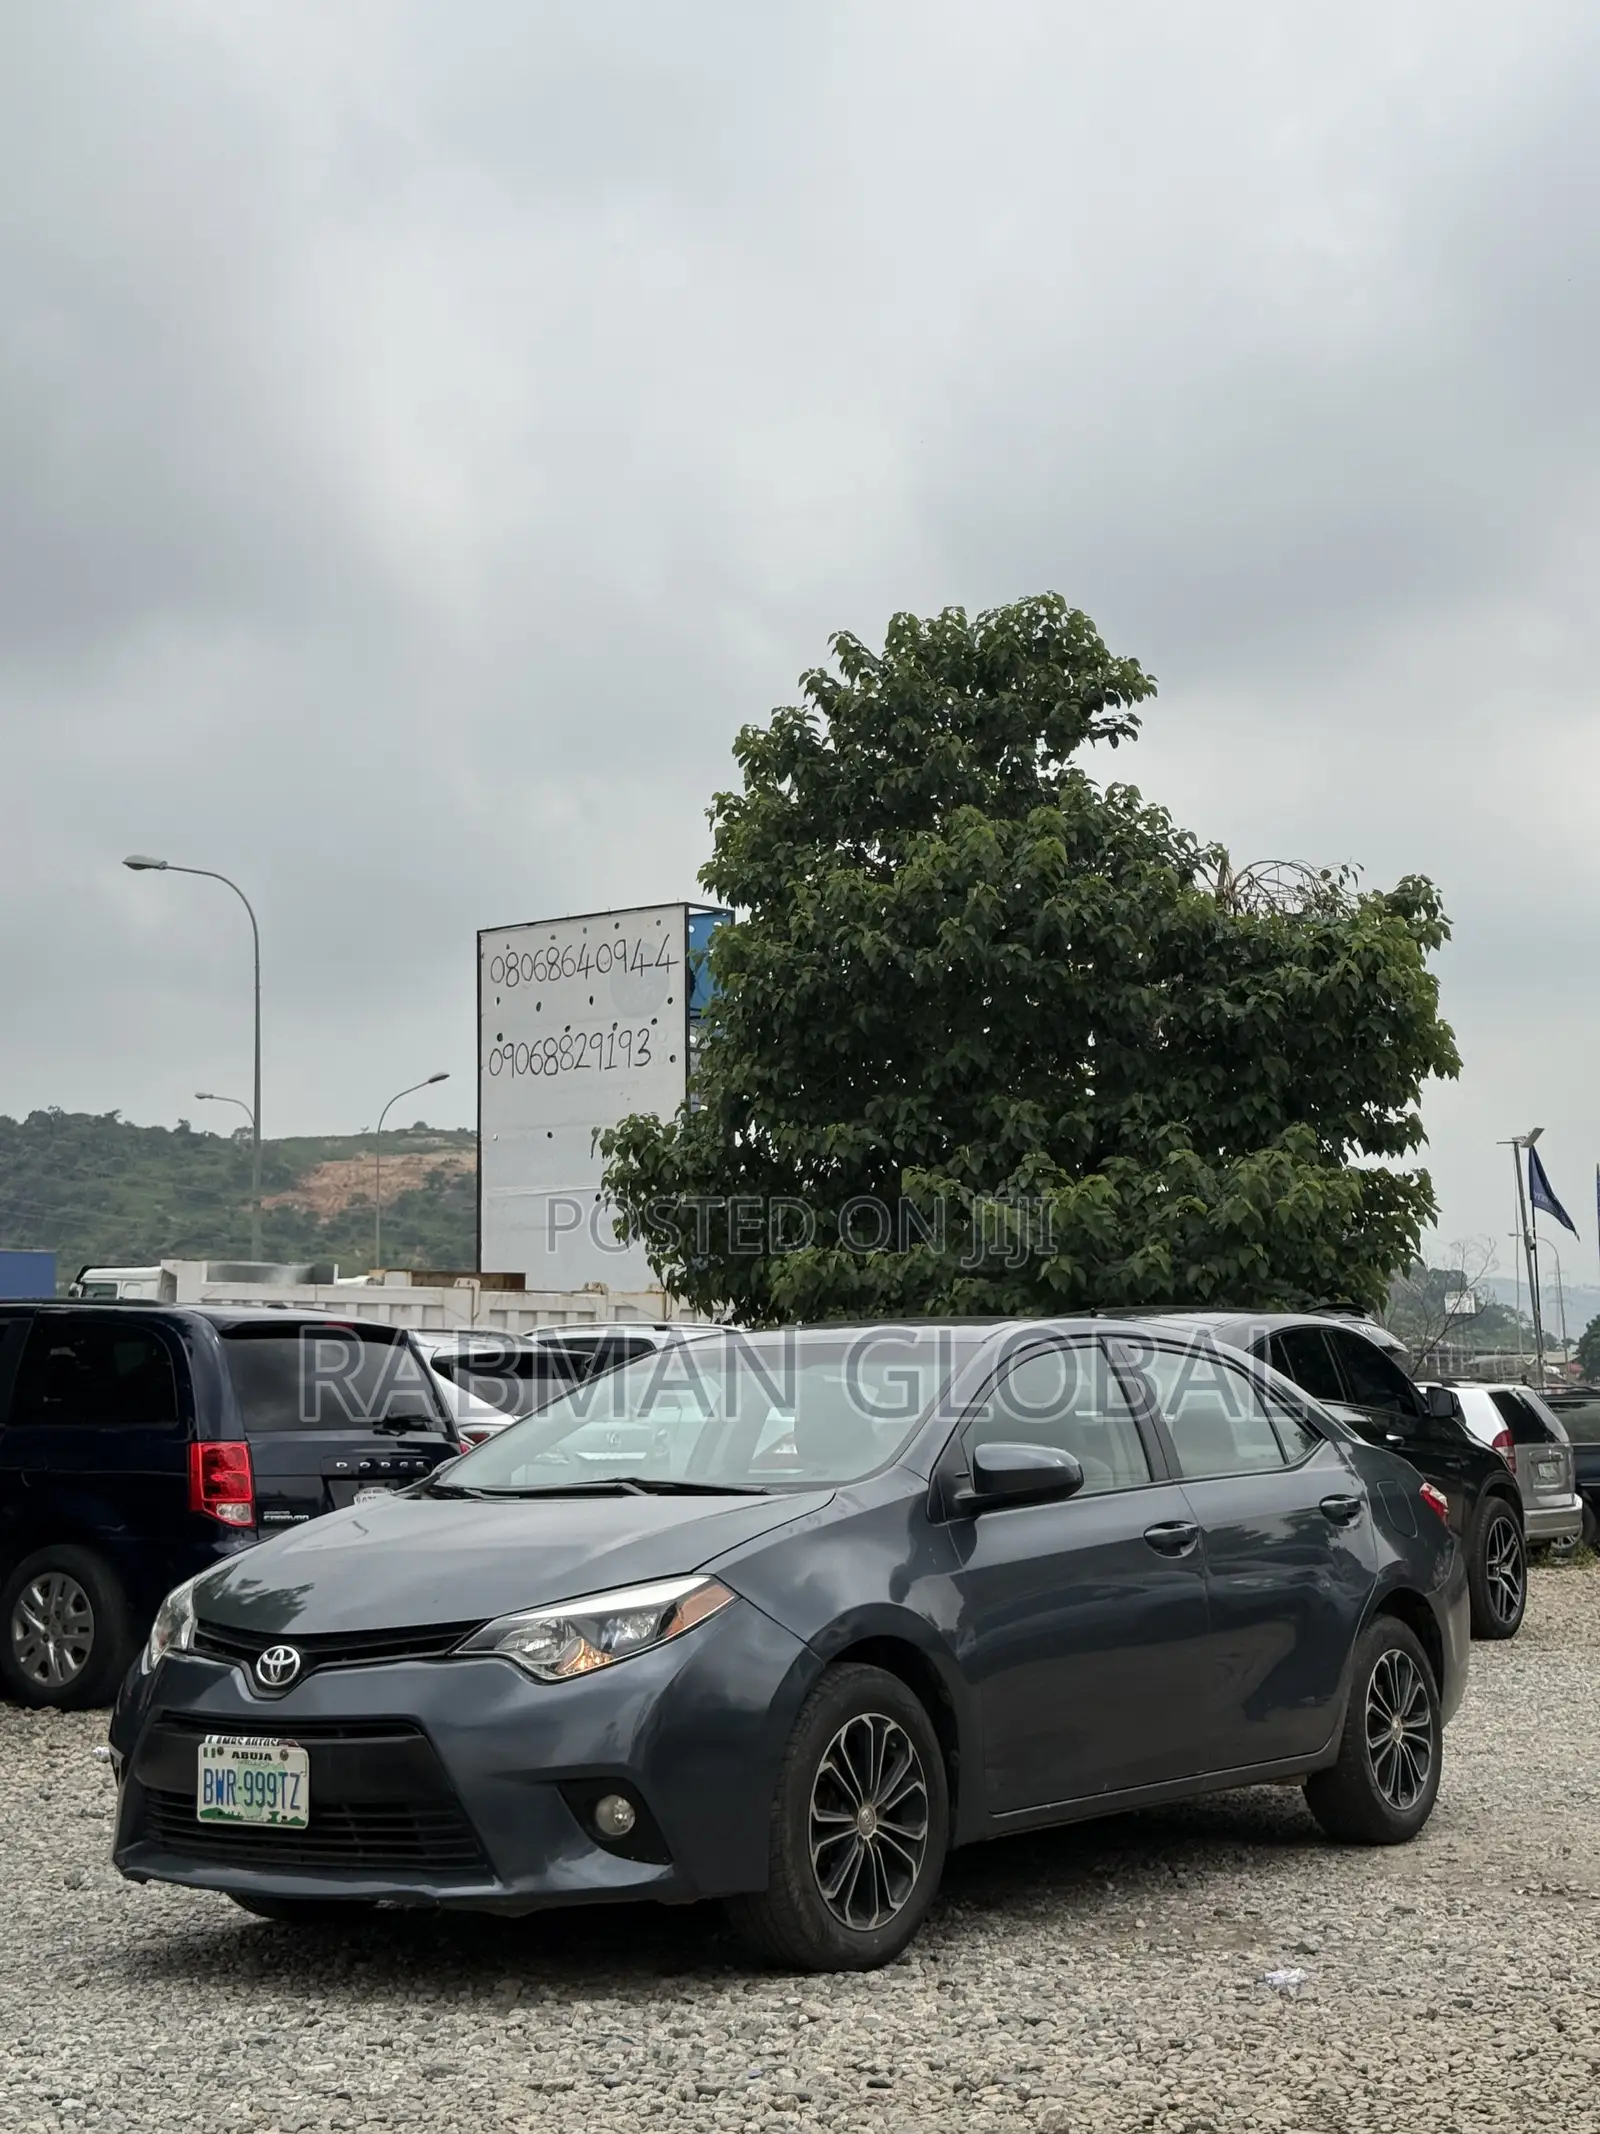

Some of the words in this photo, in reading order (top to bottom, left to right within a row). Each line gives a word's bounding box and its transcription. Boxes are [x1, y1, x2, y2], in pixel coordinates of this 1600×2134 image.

[490, 934, 679, 987] 08068640944
[488, 1028, 651, 1078] 09068829193
[231, 1751, 273, 1761] ABUJA
